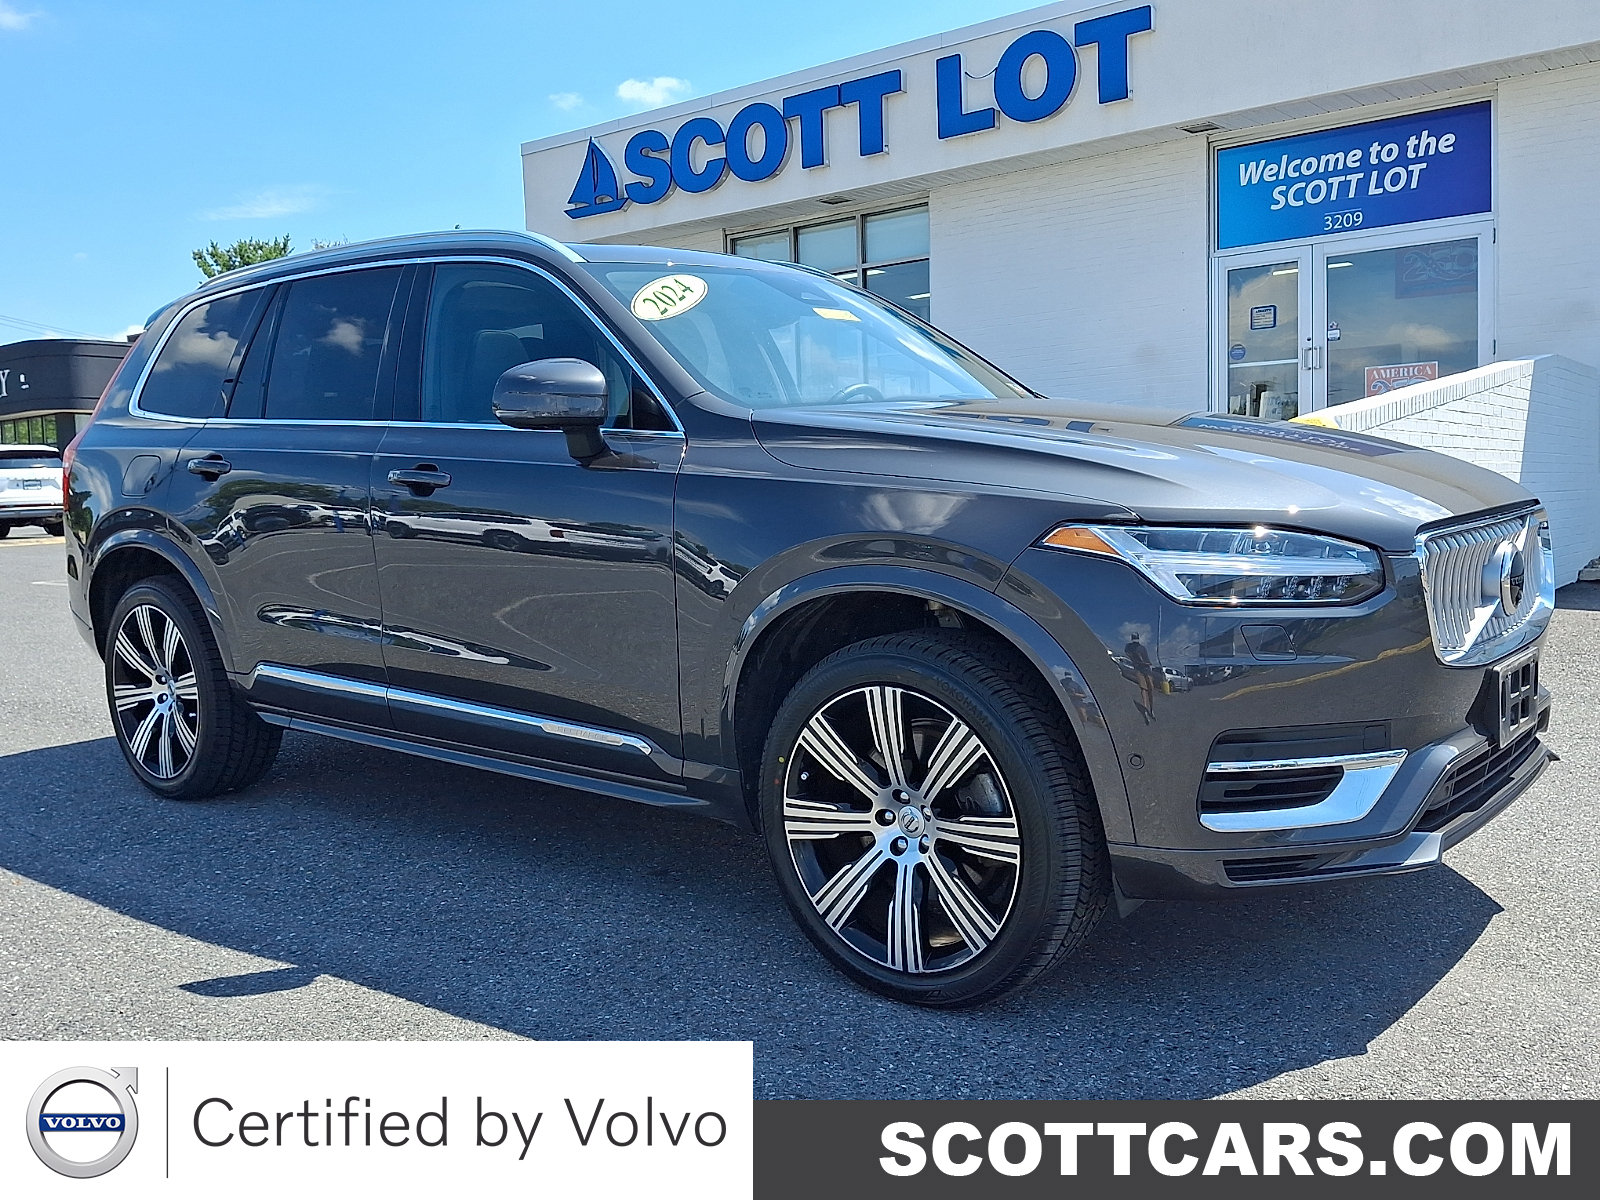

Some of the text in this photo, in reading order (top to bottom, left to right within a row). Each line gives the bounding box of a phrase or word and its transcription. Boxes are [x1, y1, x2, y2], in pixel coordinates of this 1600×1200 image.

[624, 5, 1154, 205] SCOTT LOT
[1238, 129, 1456, 187] Welcome to the
[1270, 162, 1427, 211] SCOTT LOT
[1323, 211, 1364, 231] 3209
[642, 277, 695, 317] 2024
[1371, 365, 1432, 380] AMERICA
